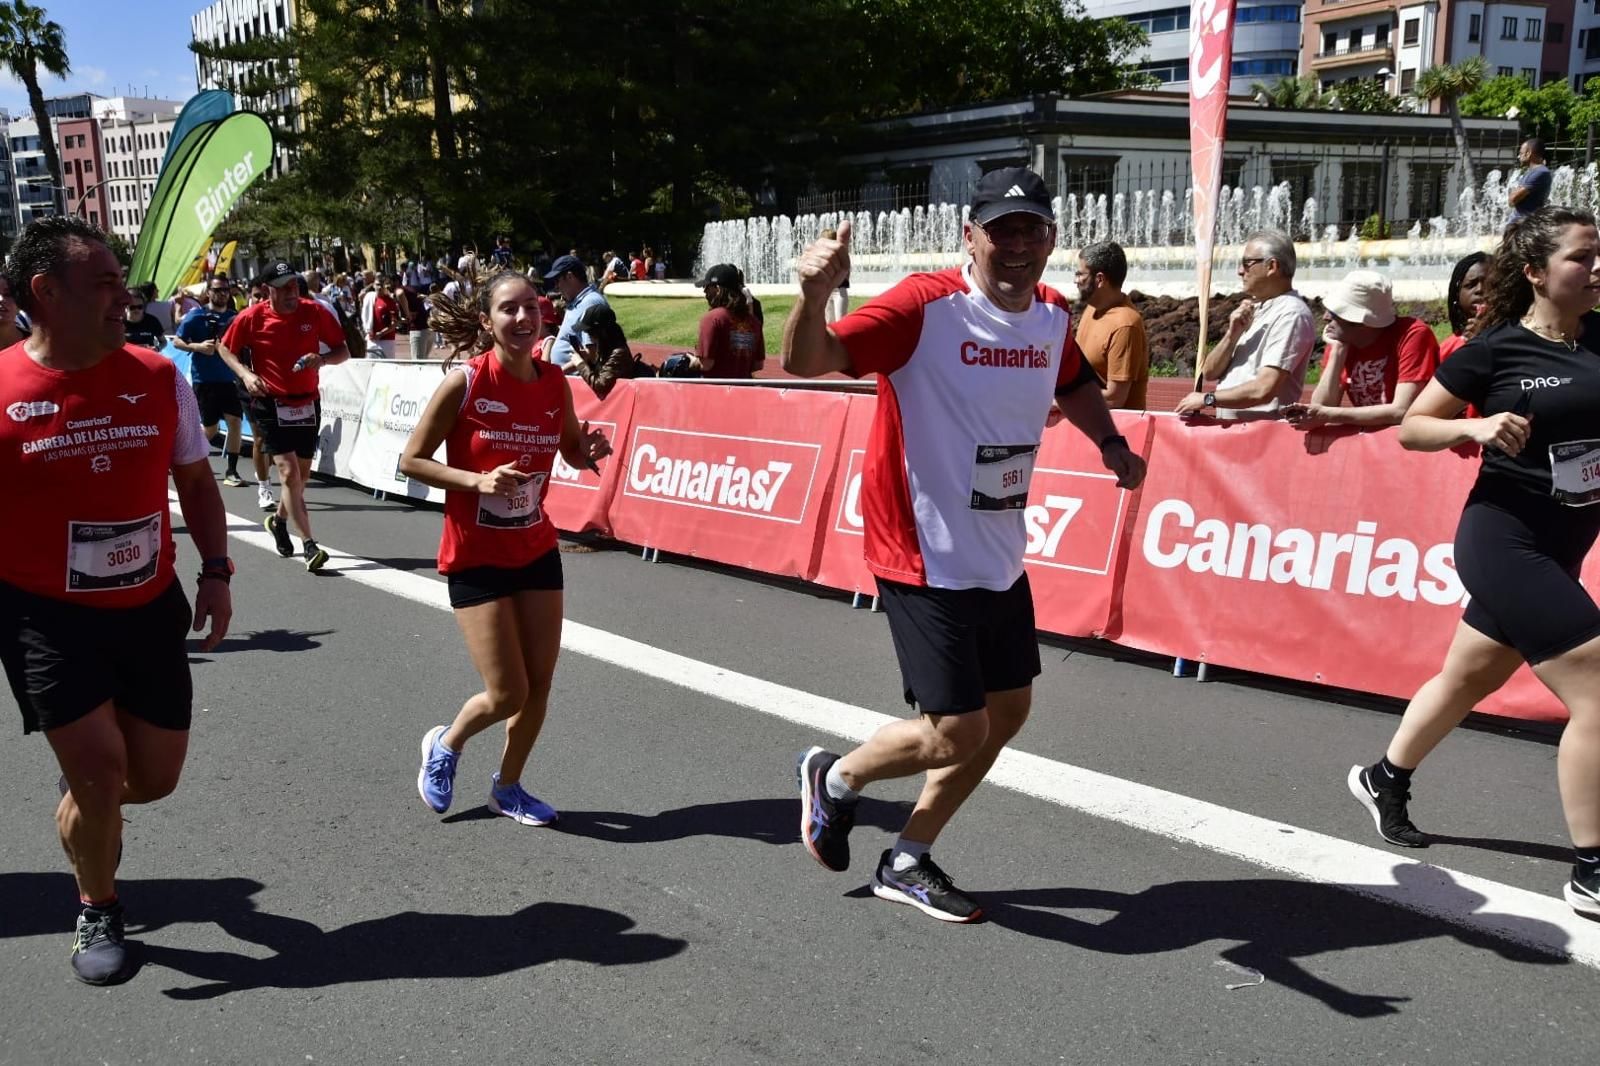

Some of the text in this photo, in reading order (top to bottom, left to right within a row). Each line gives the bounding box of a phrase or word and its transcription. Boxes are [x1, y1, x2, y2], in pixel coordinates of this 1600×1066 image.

[195, 151, 254, 233] Binter
[1520, 376, 1561, 391] DAG
[391, 394, 418, 417] Gran
[66, 415, 112, 430] Canarias7
[22, 425, 160, 454] CARRERA DE LAS EMPRESAS
[479, 429, 560, 445] CARRERA DE LAS EMPRE
[43, 439, 149, 462] LAS PALMAS DE GRAN CANARIA
[629, 443, 793, 512] Canarias7
[1002, 468, 1023, 489] 5561
[107, 545, 140, 567] 3030
[1142, 498, 1471, 609] Canarias
